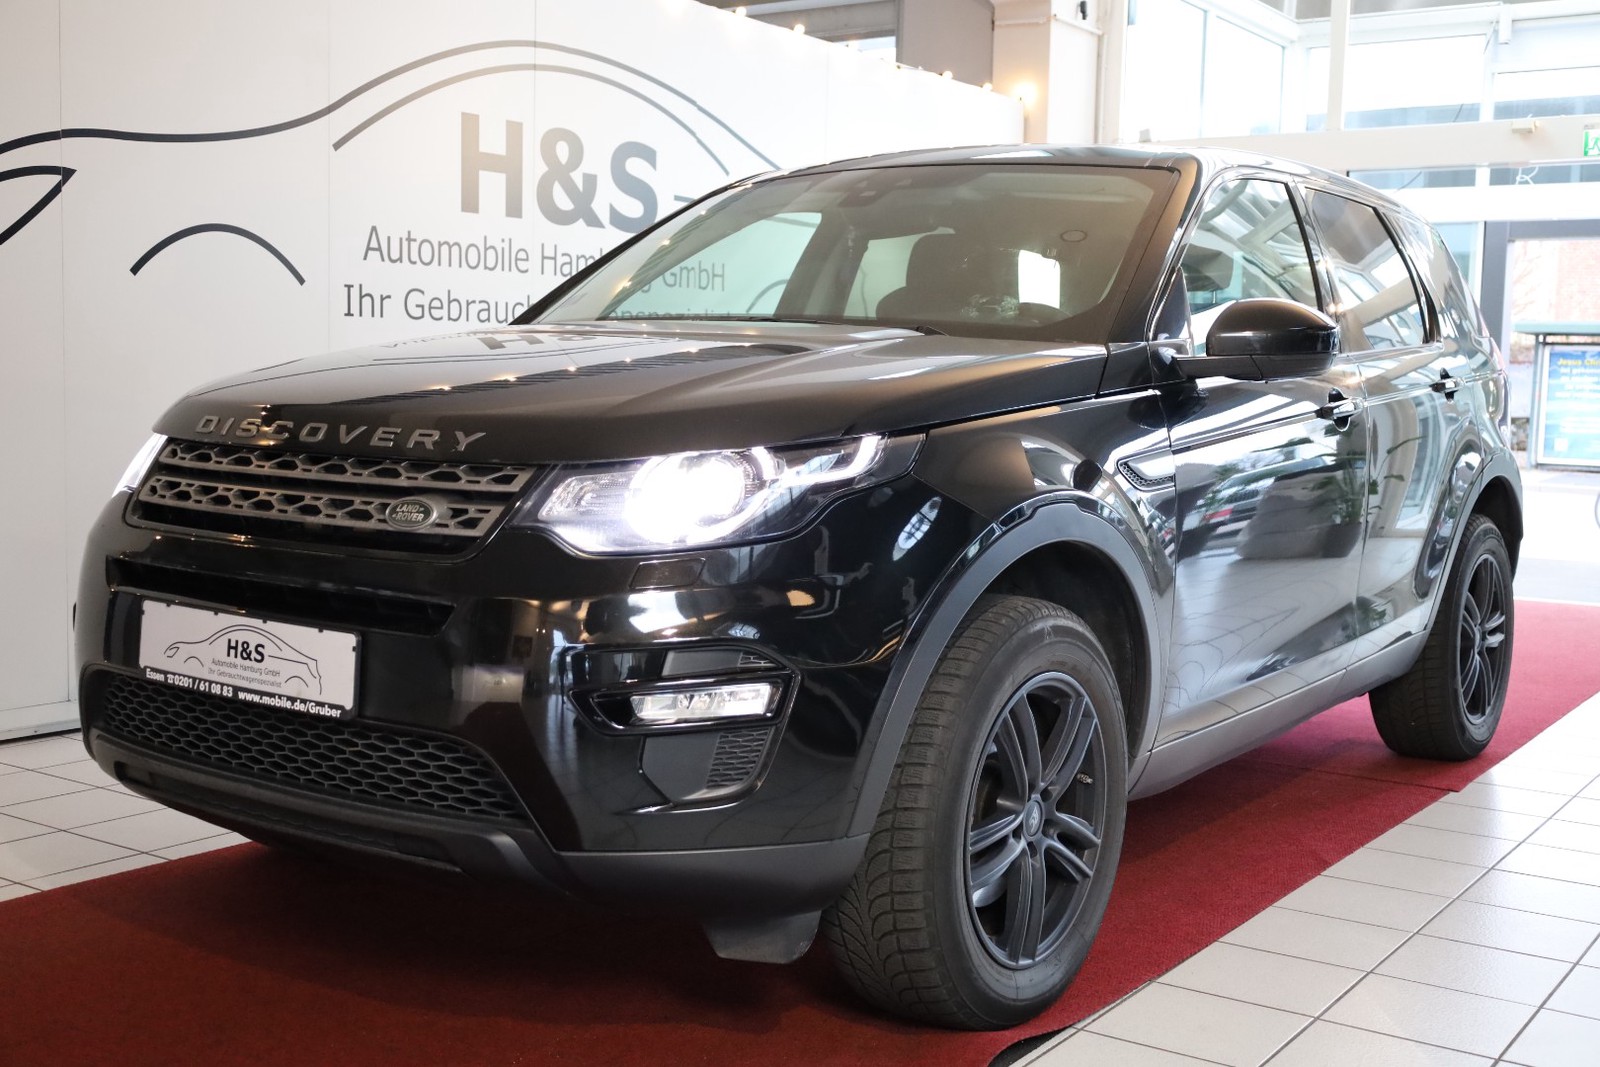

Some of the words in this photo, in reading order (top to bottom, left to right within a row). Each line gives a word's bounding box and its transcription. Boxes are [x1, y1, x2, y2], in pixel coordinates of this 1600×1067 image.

[460, 111, 659, 234] H&S
[362, 225, 530, 274] Automobile
[662, 260, 726, 292] GmbH
[343, 283, 392, 319] Ihr
[194, 415, 487, 451] DISCOVERY
[211, 658, 239, 670] Automobile
[226, 638, 266, 664] H&S
[145, 668, 165, 682] Essen
[199, 680, 210, 692] 61
[210, 683, 221, 695] 08
[222, 685, 233, 697] 83
[237, 690, 342, 718] www.mobile.de/Gruber
